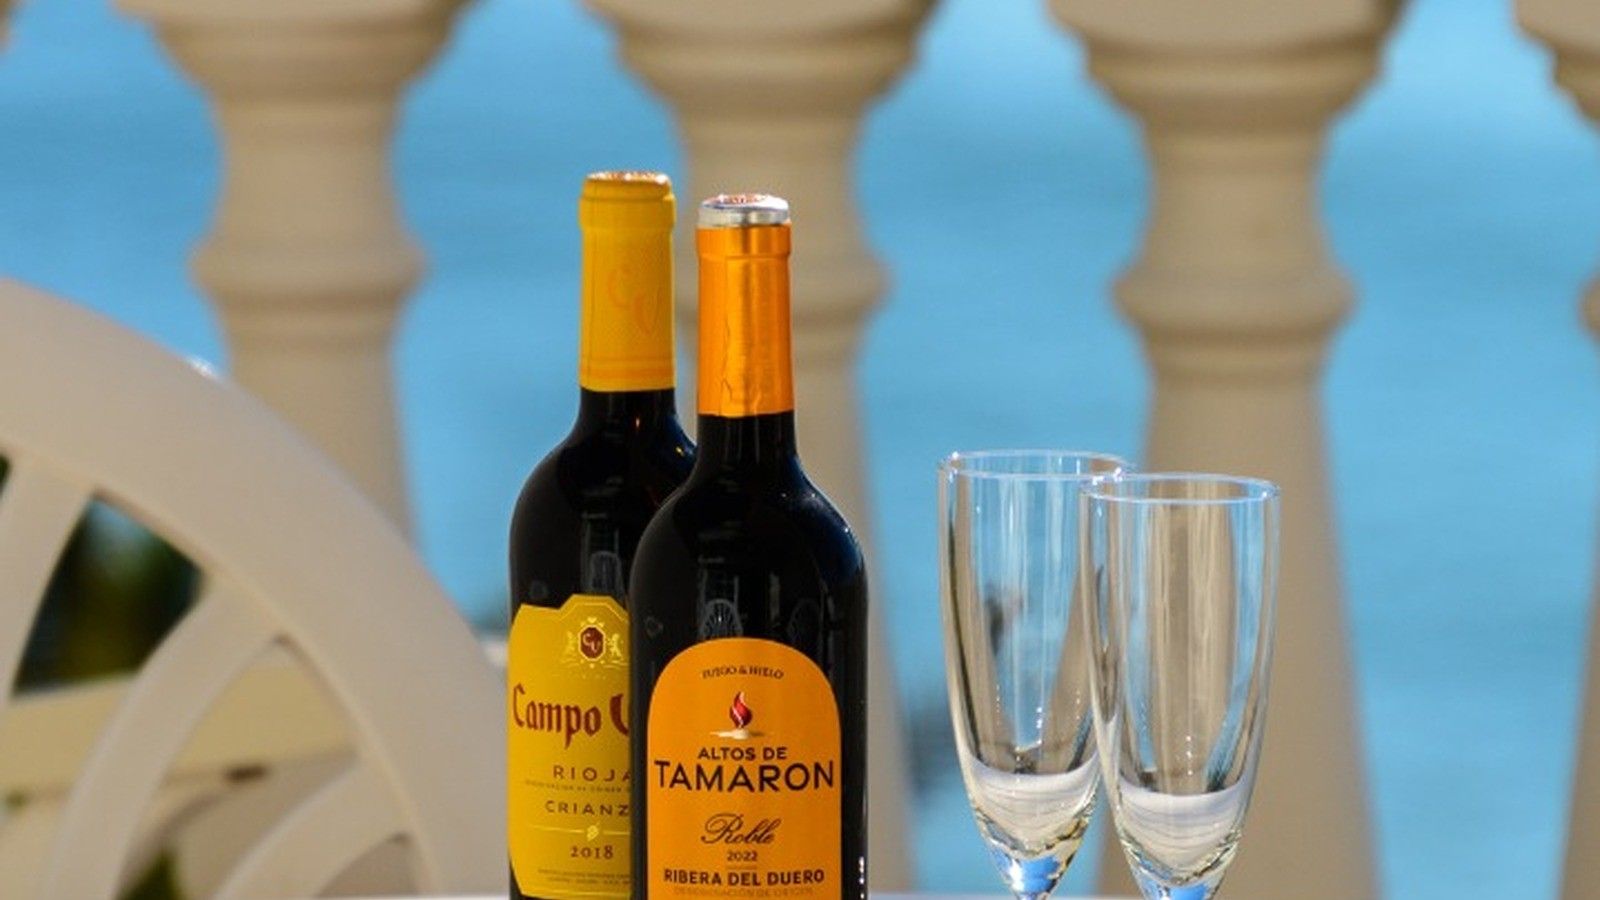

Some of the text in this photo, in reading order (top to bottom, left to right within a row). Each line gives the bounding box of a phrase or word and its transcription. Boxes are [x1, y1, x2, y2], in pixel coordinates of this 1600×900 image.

[513, 682, 602, 750] Campo
[697, 747, 788, 761] ALTOS DE
[654, 760, 834, 793] TAMARON
[545, 800, 630, 817] CRIANZ
[701, 812, 781, 844] Roble
[570, 845, 613, 860] 2018
[726, 850, 758, 862] 2022
[664, 868, 825, 886] RIBERA DEL DUERO
